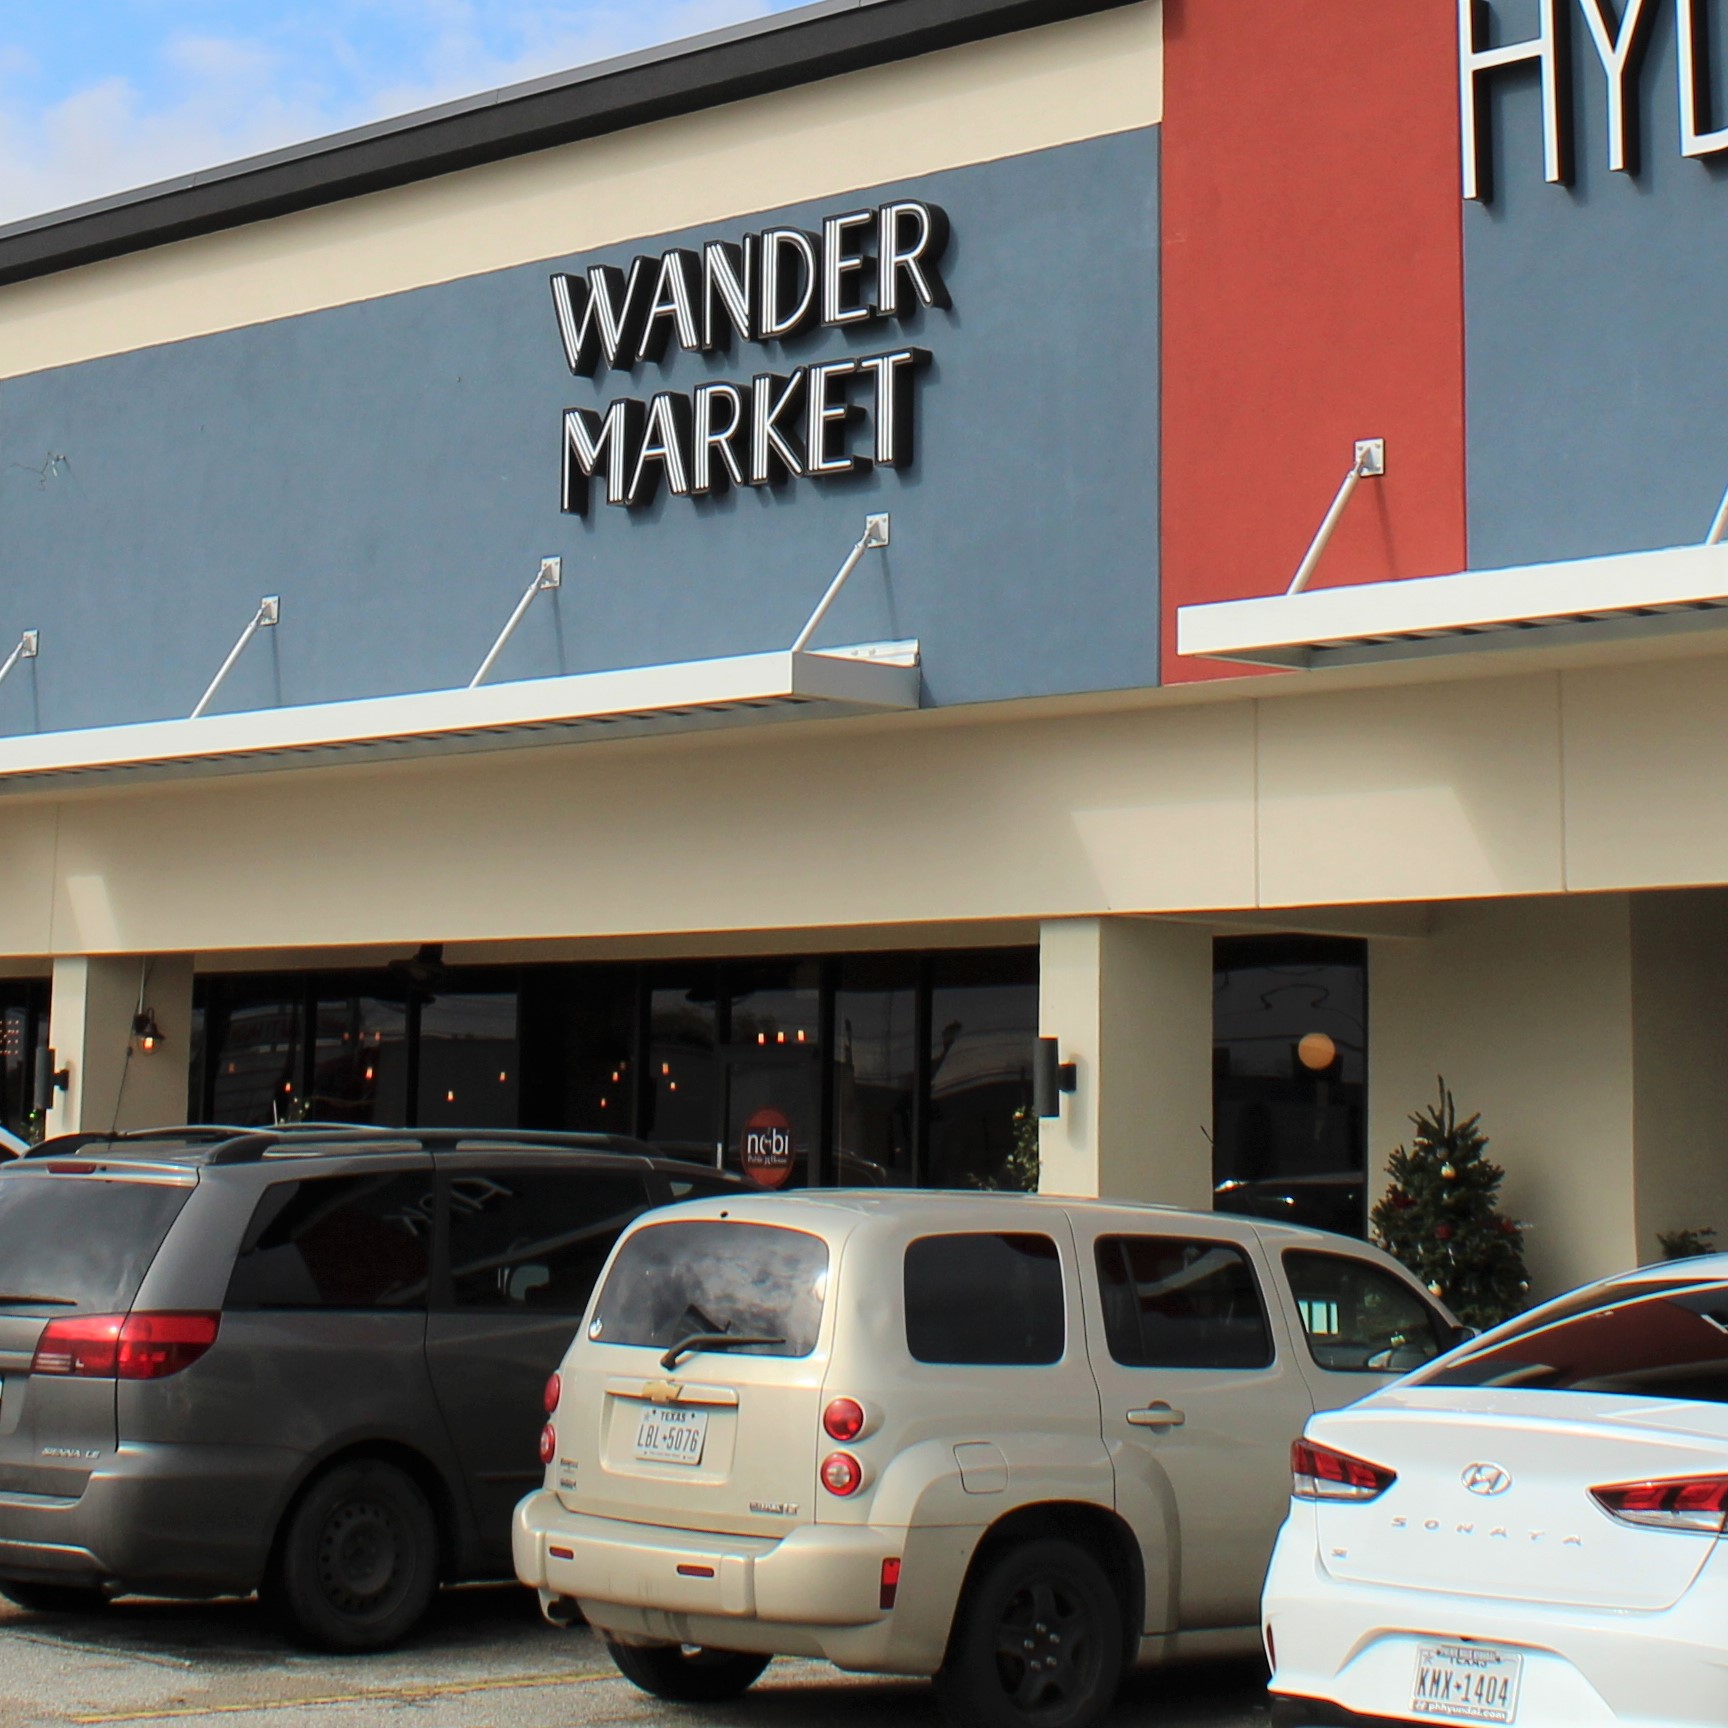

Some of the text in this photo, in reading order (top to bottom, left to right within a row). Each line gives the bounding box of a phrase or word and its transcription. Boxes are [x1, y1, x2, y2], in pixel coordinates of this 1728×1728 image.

[550, 199, 940, 375] WANDER
[561, 347, 920, 513] MARKET
[661, 1411, 686, 1422] TEXAS
[1391, 1516, 1582, 1546] SONATA
[1428, 1703, 1506, 1719] phhyundai.com
